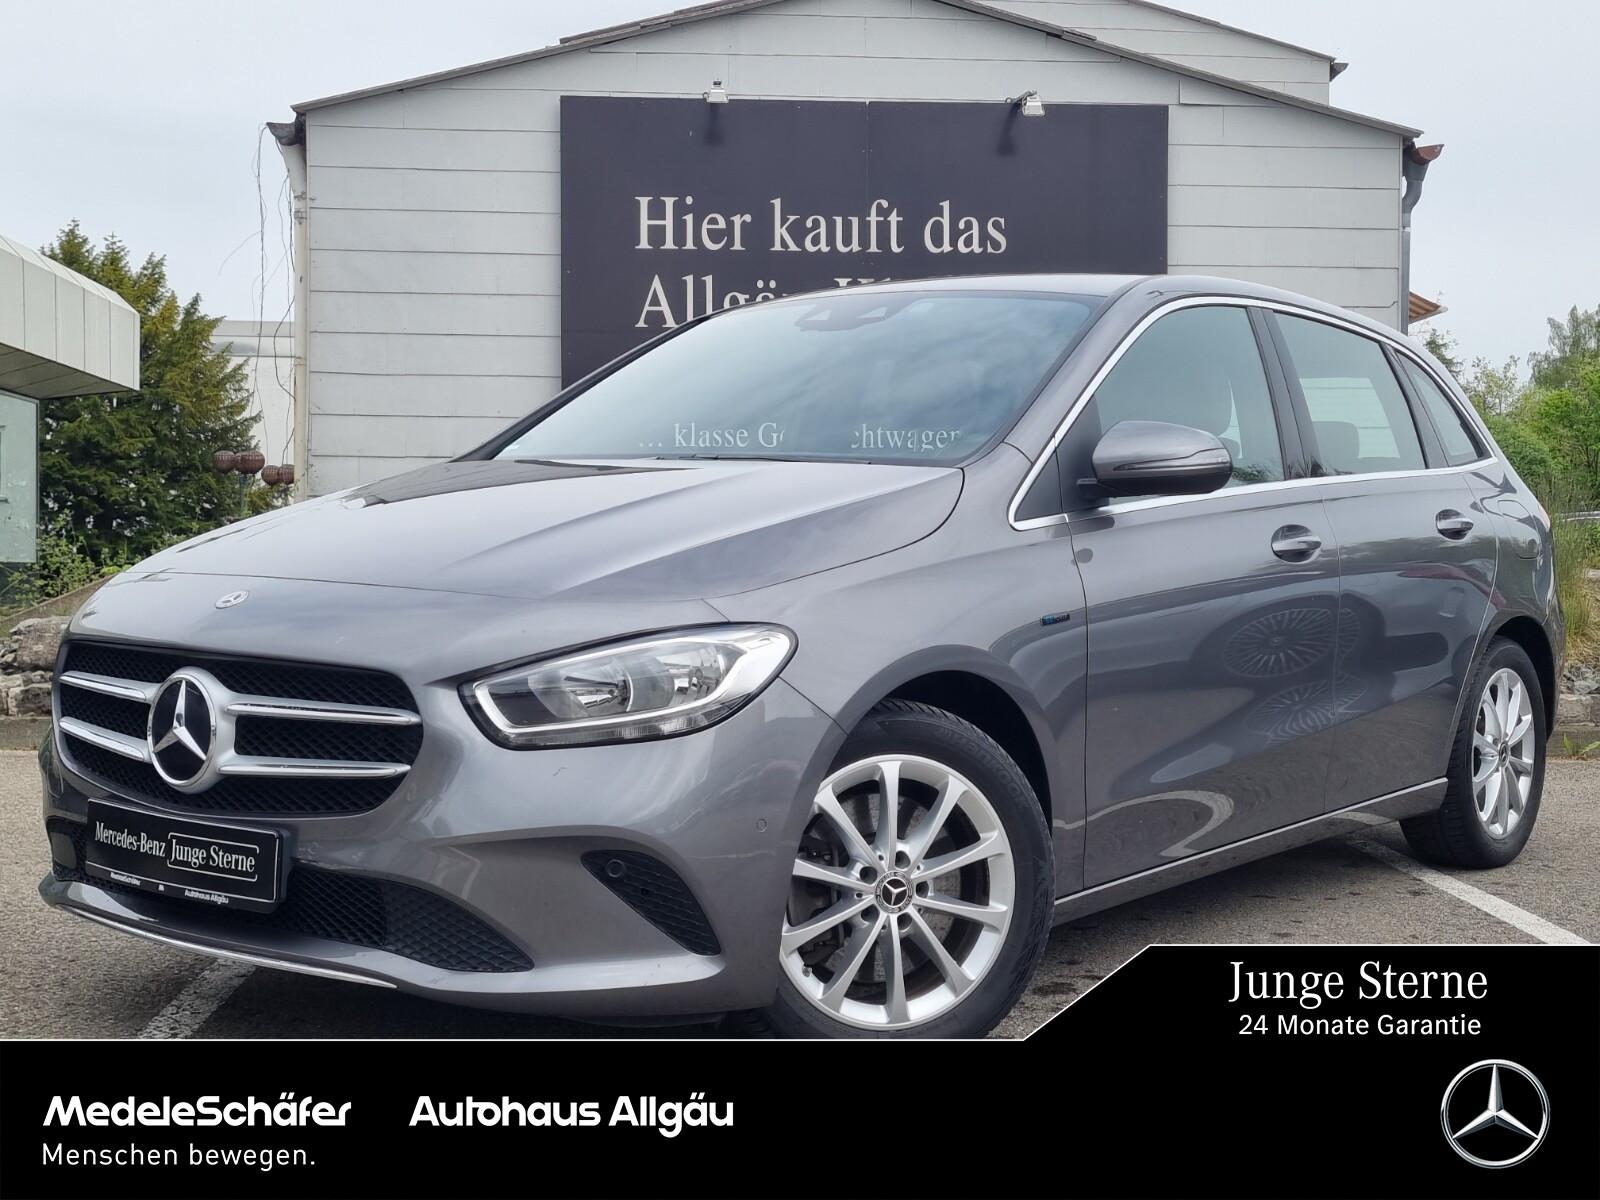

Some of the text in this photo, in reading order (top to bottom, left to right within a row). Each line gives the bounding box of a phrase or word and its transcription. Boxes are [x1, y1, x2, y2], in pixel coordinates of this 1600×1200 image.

[635, 195, 1007, 254] Hier kauft das
[674, 422, 749, 448] klasse
[94, 821, 255, 872] Mercedes-Benz Junge Sterne
